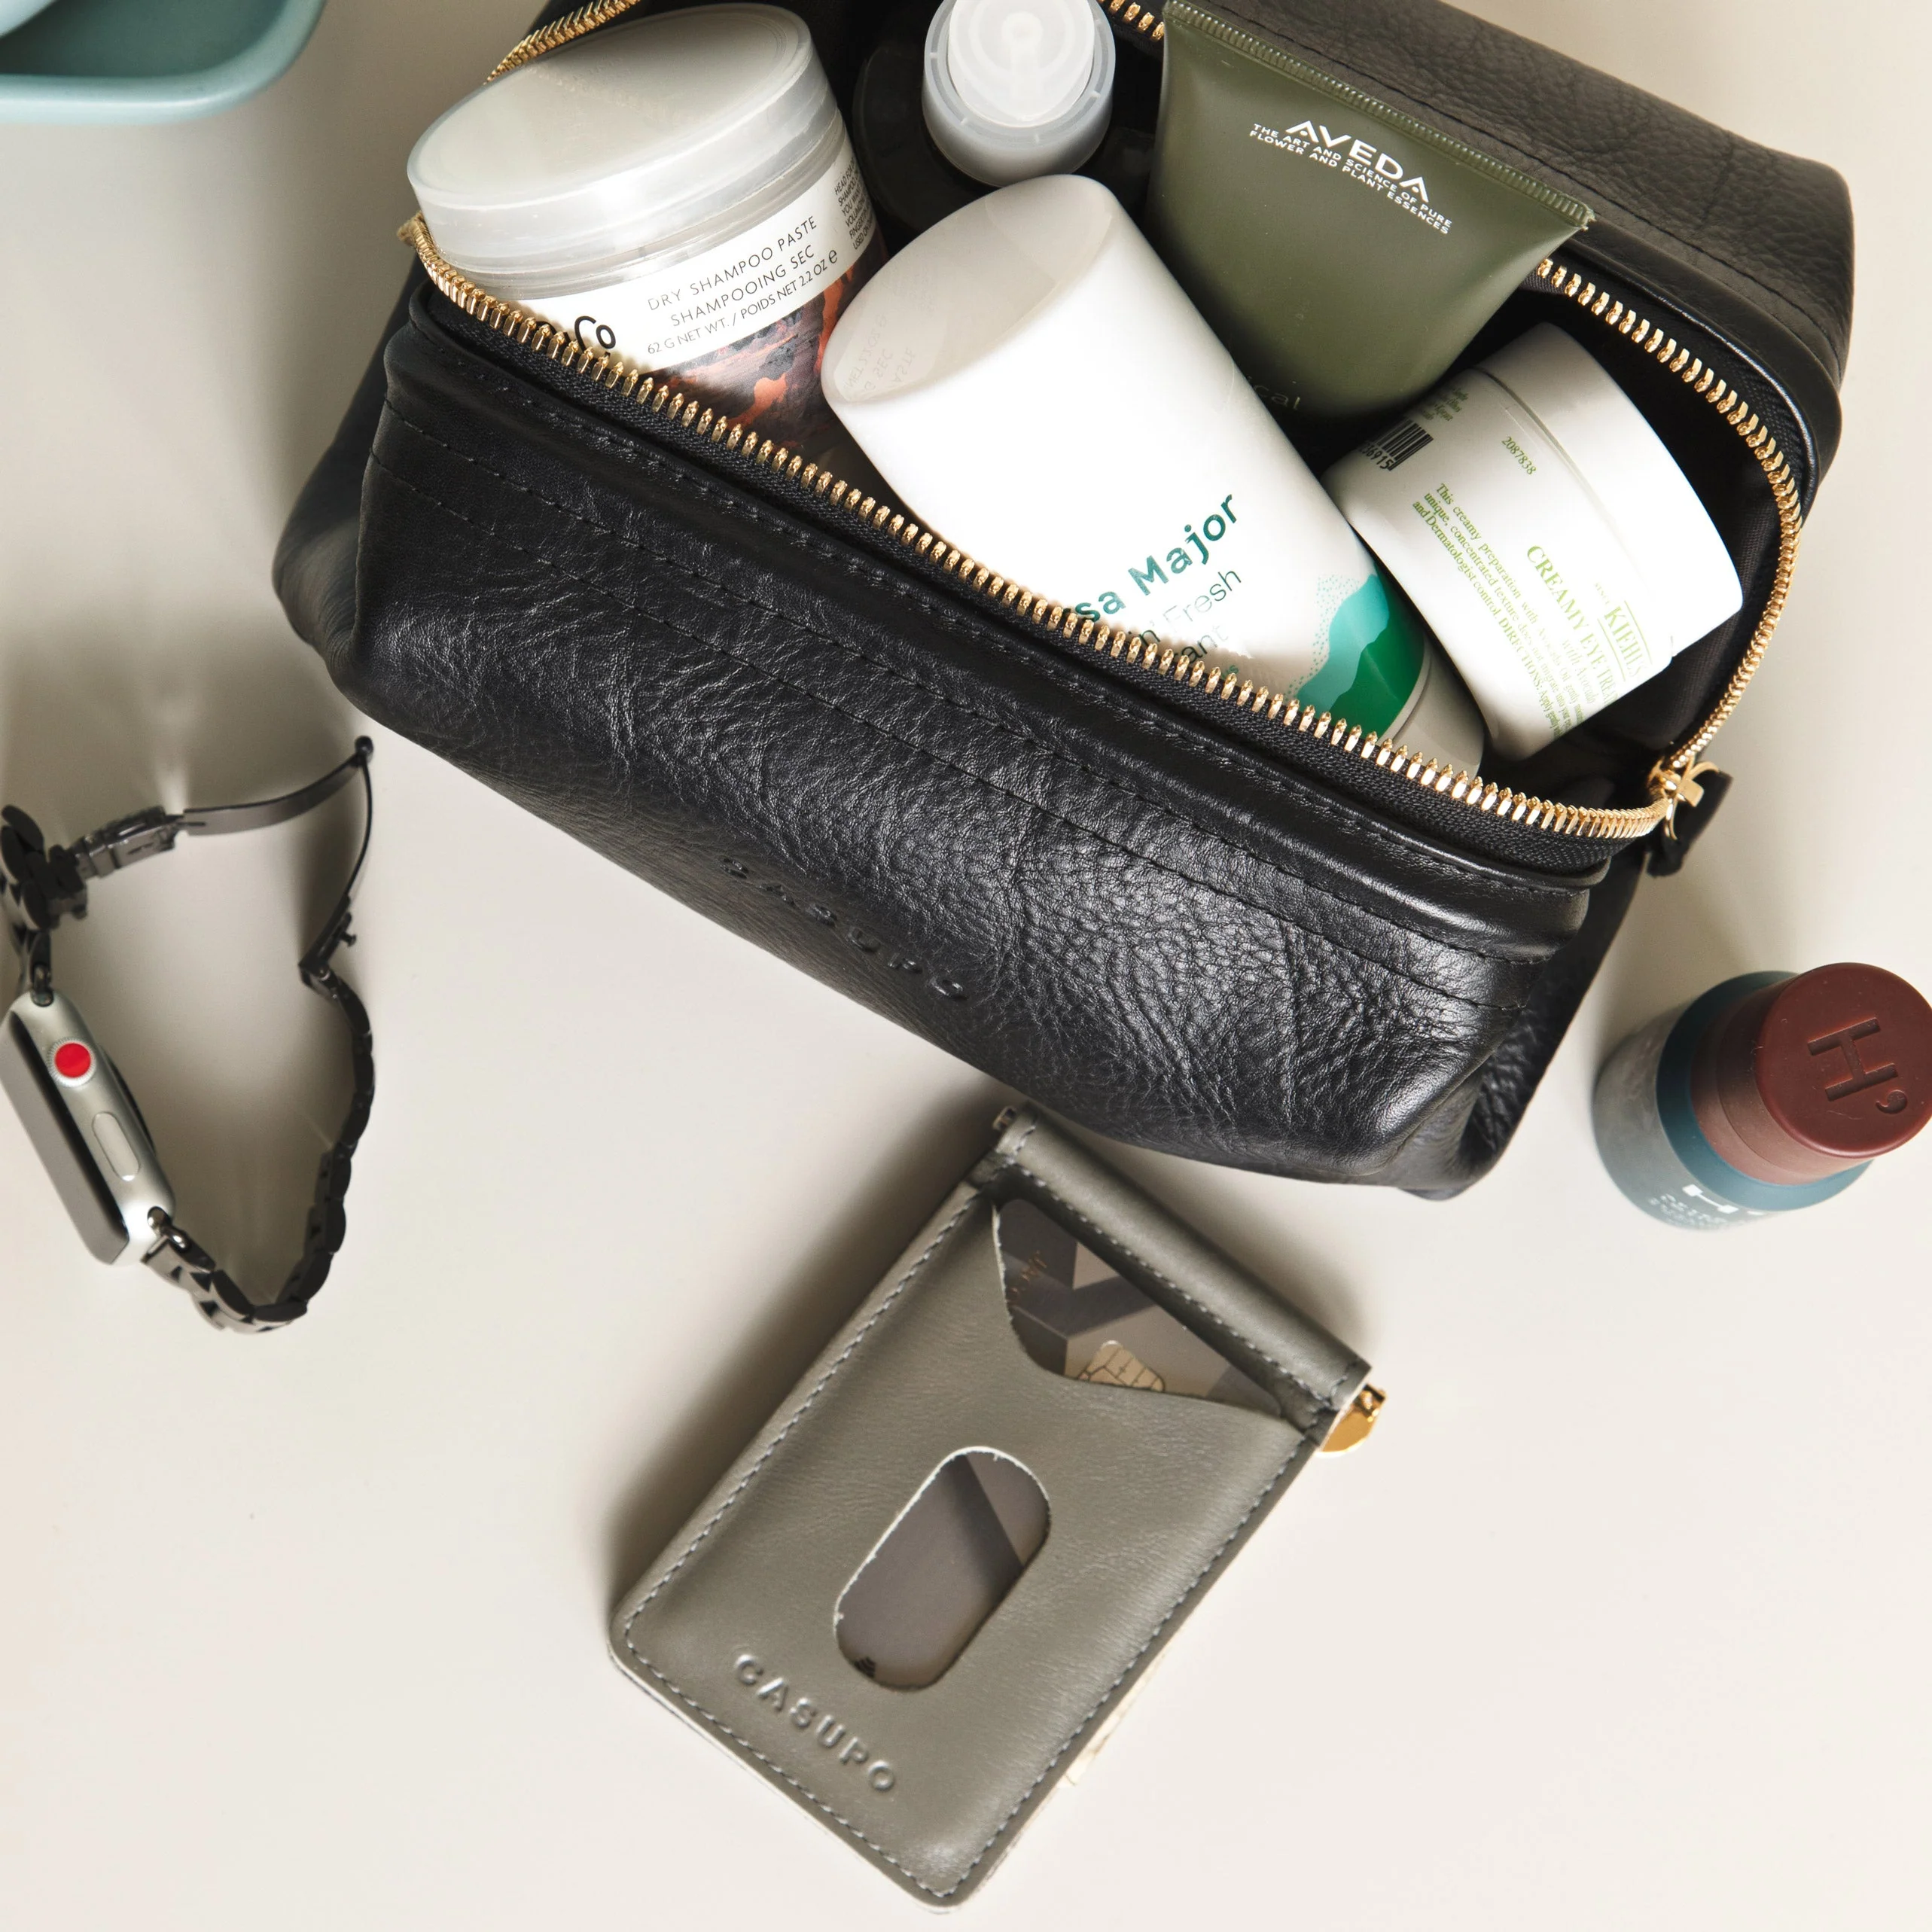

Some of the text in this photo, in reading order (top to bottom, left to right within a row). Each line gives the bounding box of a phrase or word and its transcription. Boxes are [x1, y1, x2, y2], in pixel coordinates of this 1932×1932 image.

[1248, 130, 1449, 235] FLOWER AND PLANT ESSENCES
[1253, 123, 1452, 227] THE ART AND SCIENCE OF PURE
[1284, 120, 1429, 203] AVEDA
[648, 215, 817, 311] DRY SHAMPOO PASTE
[648, 342, 662, 355] 62
[664, 337, 675, 349] G
[677, 328, 701, 345] NET
[705, 318, 730, 334] WT.
[740, 294, 776, 319] POIDS
[776, 280, 797, 300] NET
[798, 270, 813, 287] 2.2
[670, 245, 815, 327] SHAMPOOING SEC
[1501, 436, 1537, 475] 2087838
[1063, 494, 1238, 623] sa Major
[1163, 570, 1242, 632] Fresh
[1412, 501, 1431, 518] and
[1425, 515, 1476, 581] Dermatologist
[1473, 581, 1502, 619] control.
[1498, 617, 1543, 690] DIRECTIONS:
[1424, 492, 1450, 526] unique,
[1450, 526, 1498, 587] concentrated
[1495, 587, 1520, 622] texture
[1437, 483, 1454, 505] This
[1452, 506, 1482, 541] creamy
[1478, 543, 1522, 599] preparation
[1521, 602, 1539, 624] with
[1173, 624, 1230, 663] ant
[1527, 546, 1589, 631] CREAMY
[1580, 633, 1607, 669] EYE
[733, 1654, 896, 1792] CASUPO
